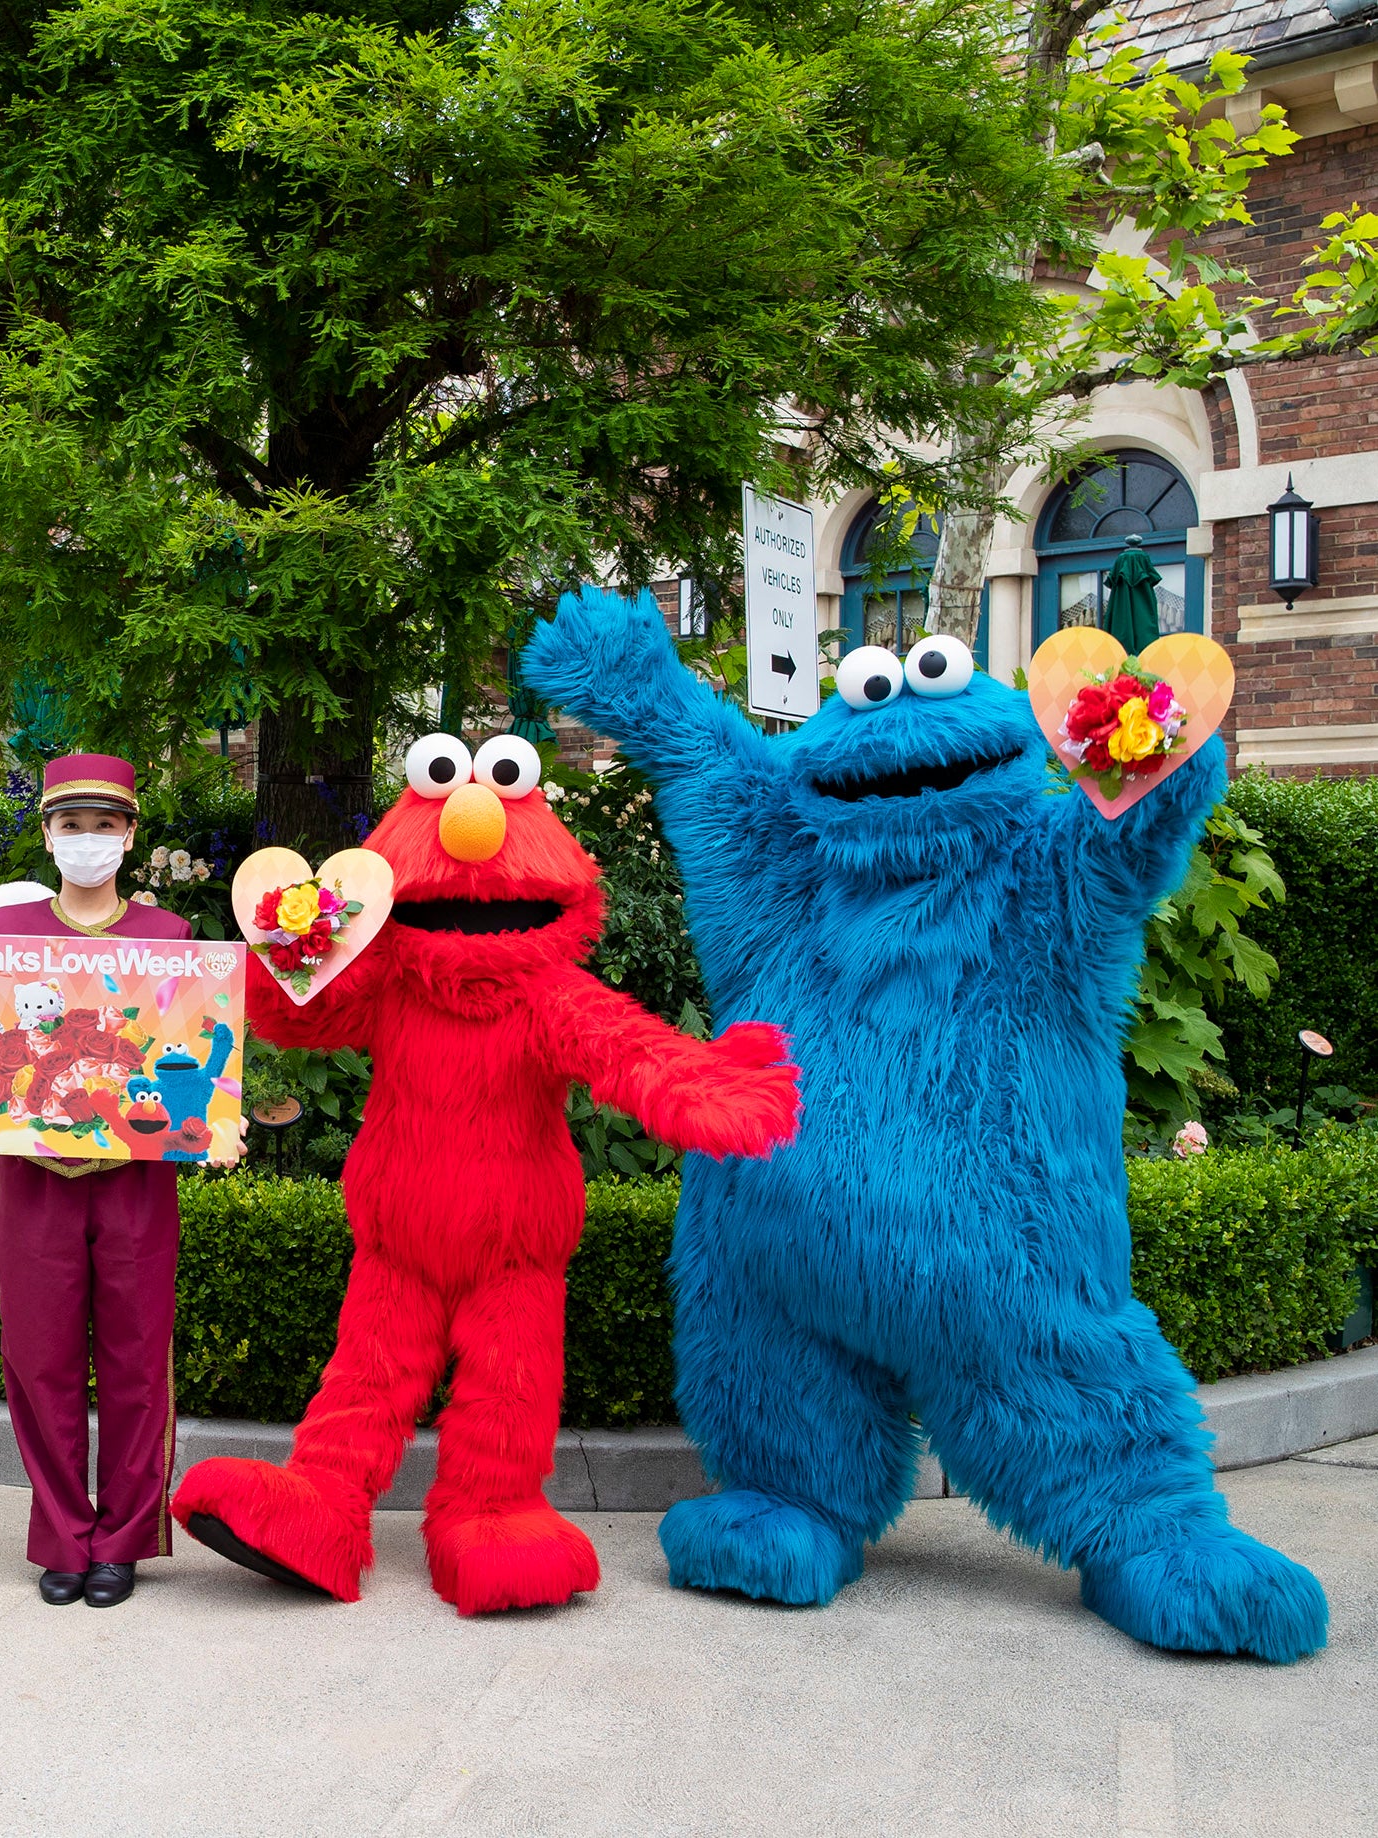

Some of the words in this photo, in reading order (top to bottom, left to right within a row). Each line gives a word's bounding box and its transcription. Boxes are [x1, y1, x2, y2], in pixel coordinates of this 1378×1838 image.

[754, 526, 806, 558] AUTHORIZED
[762, 566, 802, 595] VEHICLES
[772, 607, 794, 629] ONLY
